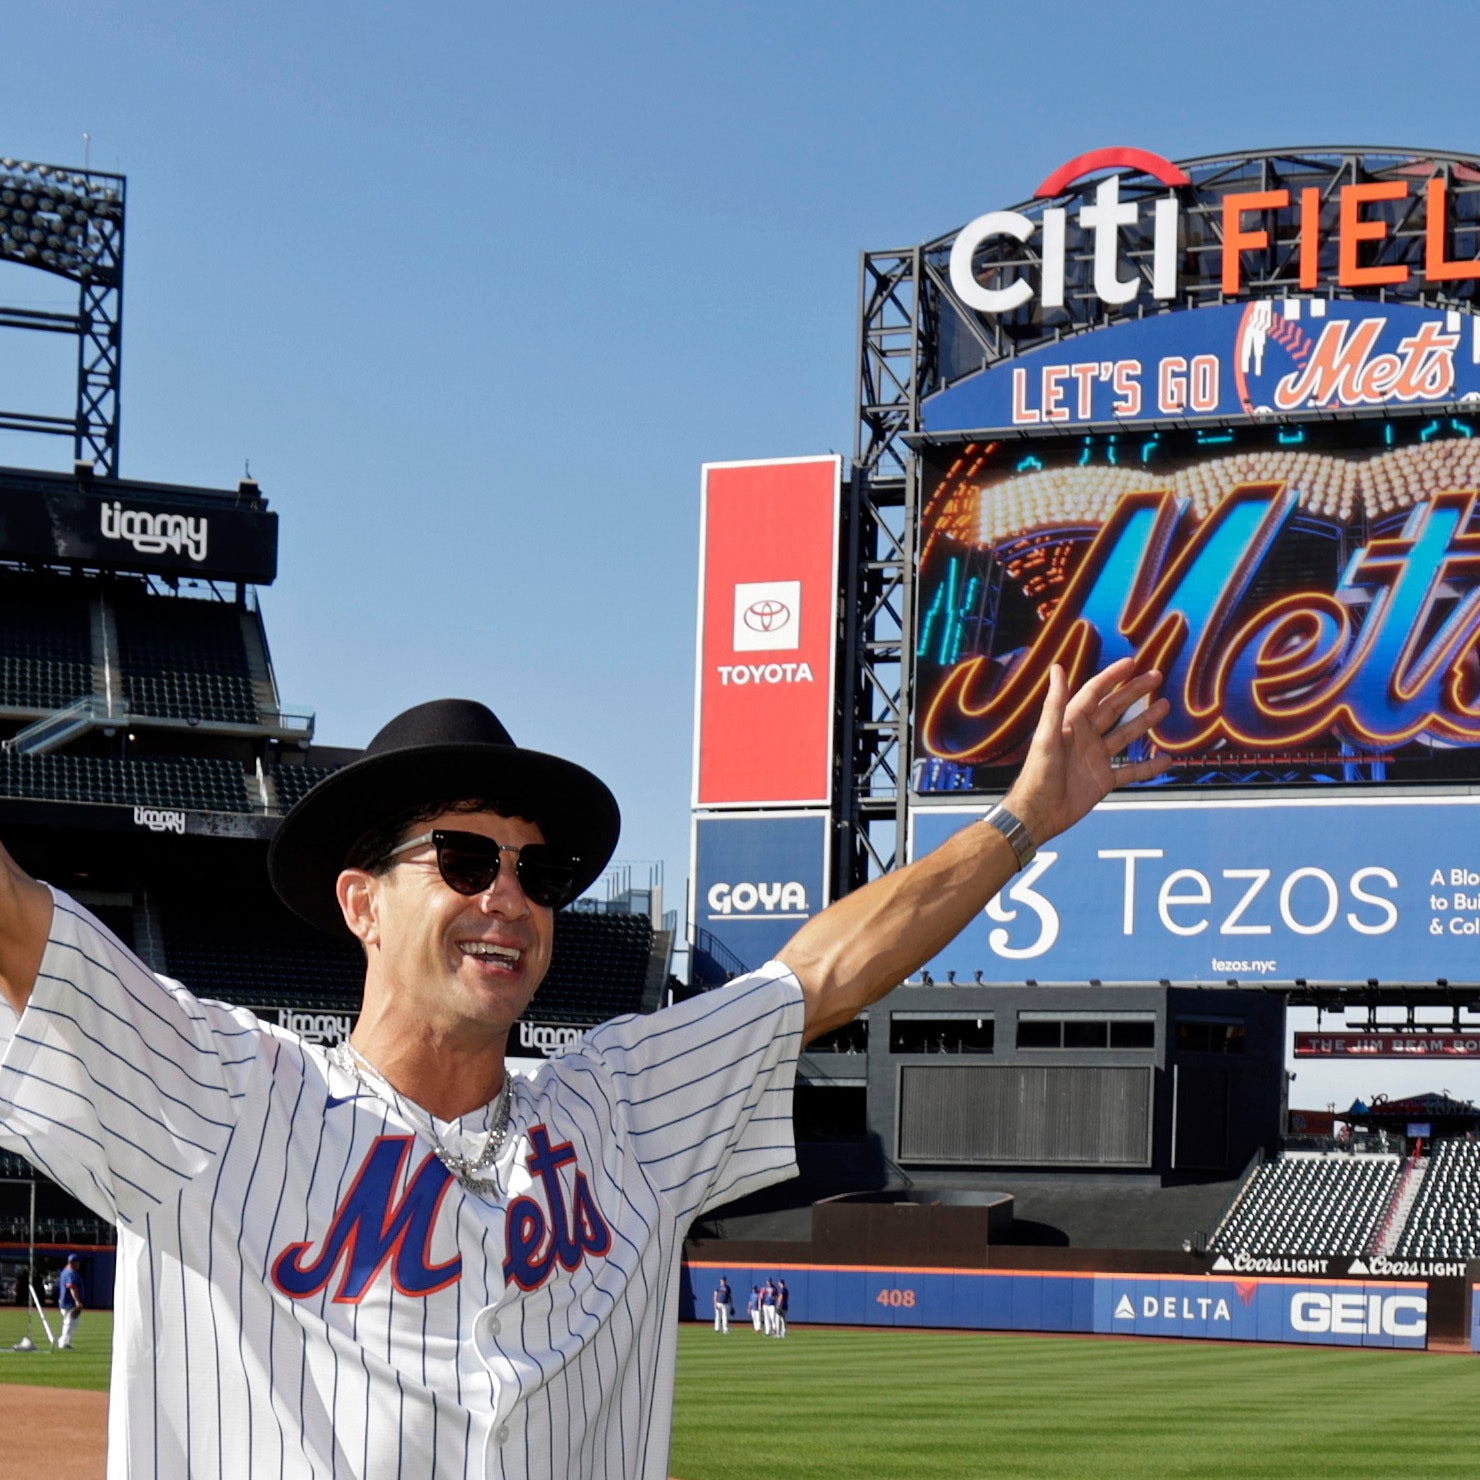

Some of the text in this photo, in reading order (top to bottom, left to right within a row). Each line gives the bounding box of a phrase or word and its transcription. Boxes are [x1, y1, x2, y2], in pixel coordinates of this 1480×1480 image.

[949, 175, 1178, 313] citi
[1275, 316, 1457, 410] Mets
[1012, 354, 1219, 423] LET'S GO
[100, 502, 207, 562] timmy
[717, 661, 813, 687] TOYOTA
[133, 806, 185, 835] timmy
[1430, 868, 1445, 886] A
[707, 881, 810, 914] GOYA
[1098, 849, 1400, 937] Tezos
[1430, 894, 1448, 911] to
[1429, 917, 1443, 935] &
[1211, 957, 1277, 973] tezos.nyc
[1309, 1038, 1345, 1051] THE
[1353, 1039, 1383, 1051] JIM
[1392, 1039, 1444, 1051] BEAM
[271, 1123, 611, 1304] Mets
[1233, 1253, 1329, 1274] Coors LIGHT
[1369, 1256, 1466, 1277] Coors LIGHT
[876, 1289, 915, 1308] 408
[1142, 1296, 1230, 1321] DELTA
